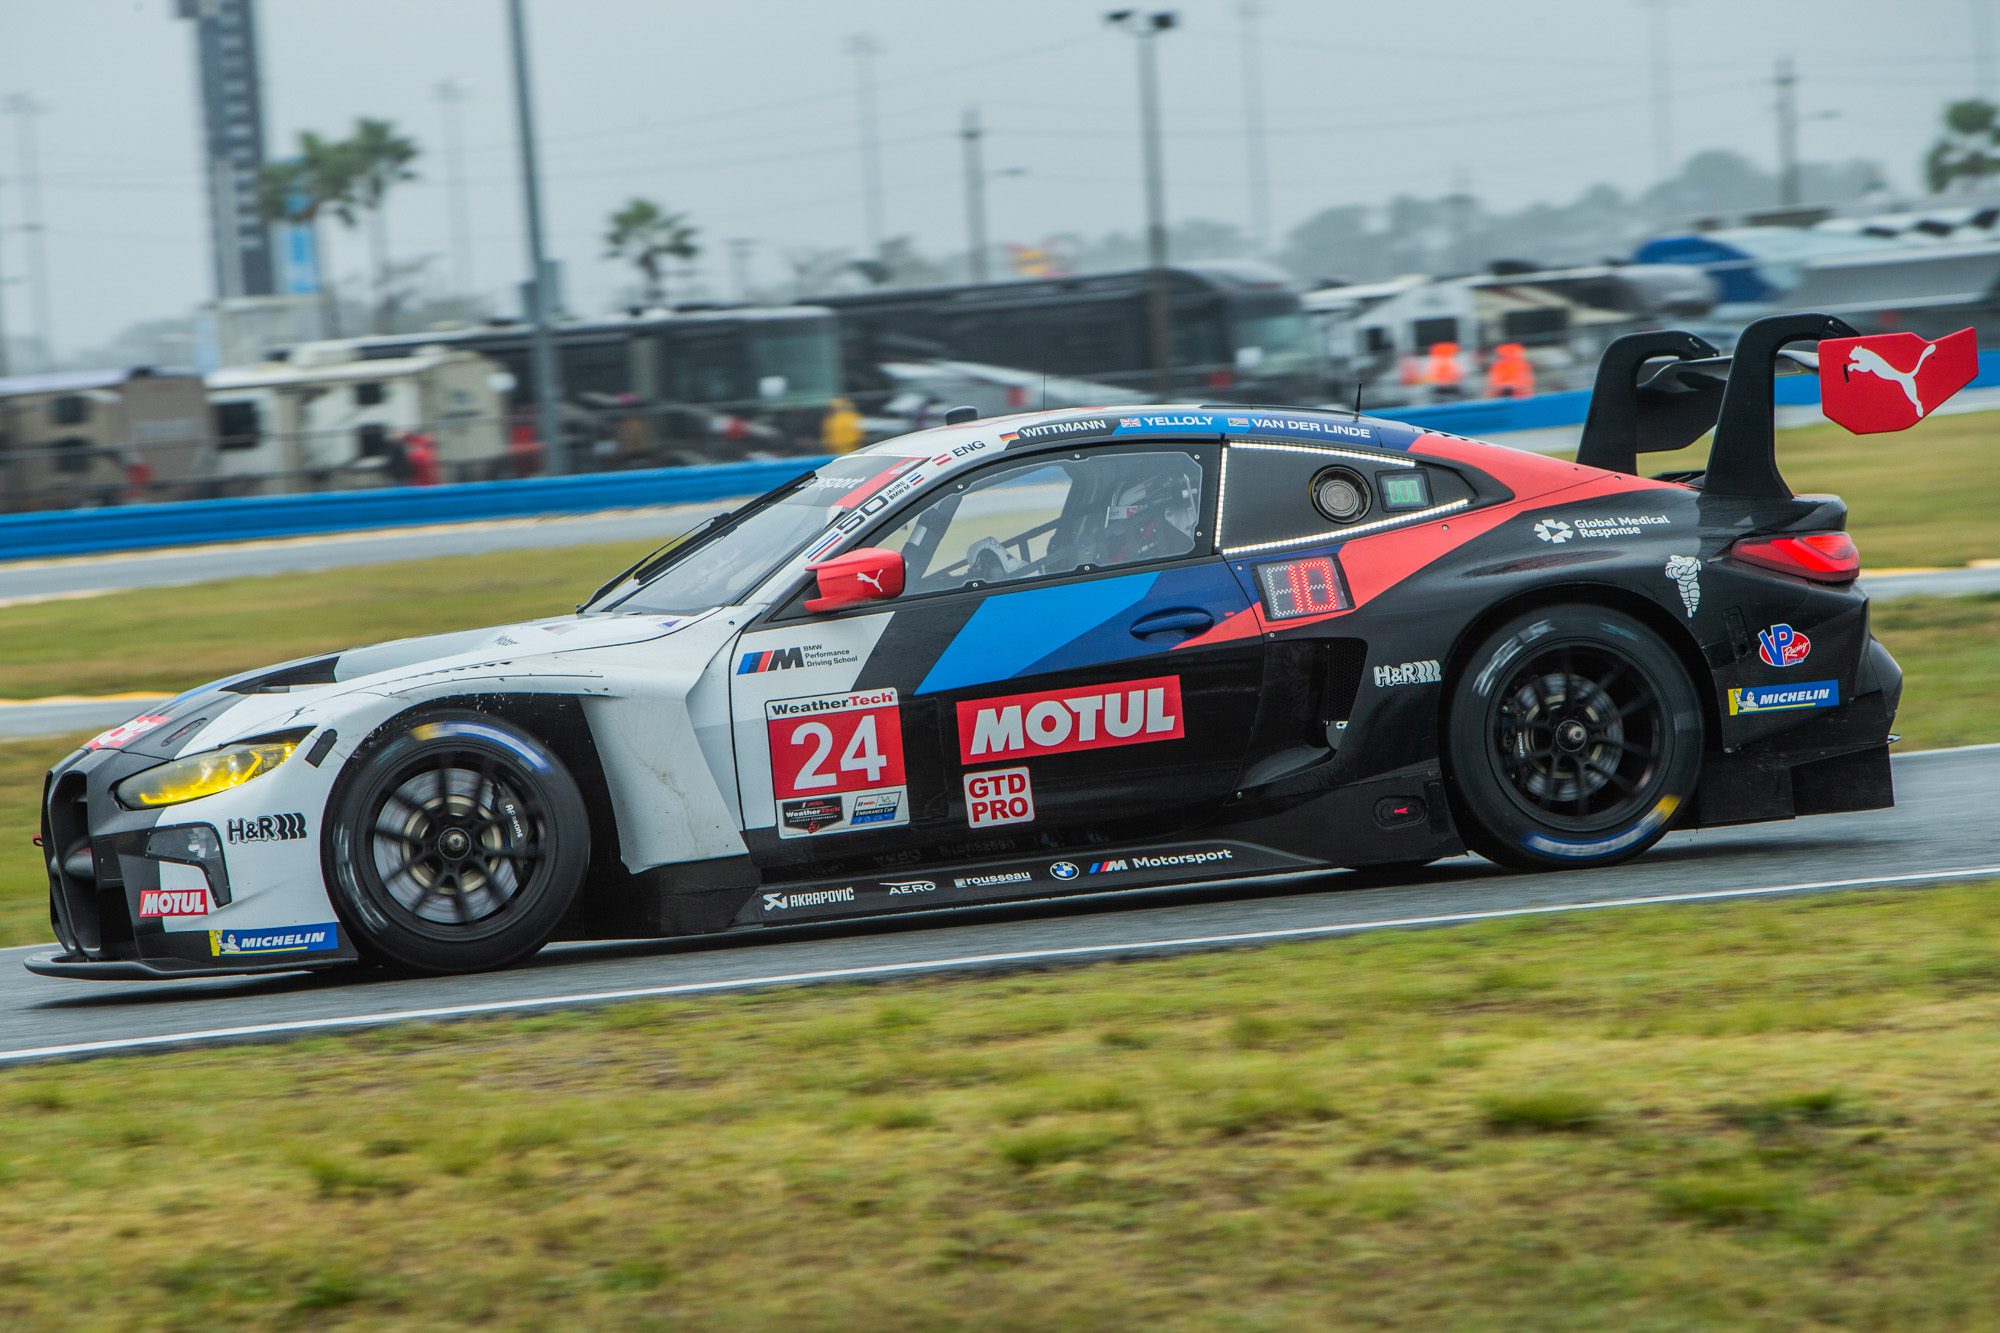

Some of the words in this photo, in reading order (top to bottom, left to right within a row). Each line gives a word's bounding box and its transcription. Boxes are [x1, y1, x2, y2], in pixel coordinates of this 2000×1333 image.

[1020, 420, 1107, 438] WITTMANN
[1143, 415, 1214, 427] YELLOLY
[1252, 418, 1285, 429] VAN
[1288, 421, 1321, 432] DER
[1324, 424, 1371, 439] LINDE
[952, 440, 987, 457] ENG
[889, 487, 905, 500] BMW
[836, 494, 890, 535] 50
[1574, 518, 1617, 529] Global
[1617, 515, 1670, 526] Medical
[1579, 526, 1642, 538] Response
[803, 644, 823, 652] BMW
[1758, 624, 1794, 665] VP
[1784, 641, 1808, 659] Racing
[805, 649, 850, 659] Performance
[833, 656, 858, 664] School
[1374, 662, 1419, 687] H&R
[771, 693, 892, 715] WeatherTech
[1760, 688, 1829, 705] MICHELIN
[970, 688, 1176, 755] MOTUL
[790, 714, 888, 791] 24
[968, 773, 1026, 799] GTD
[971, 796, 1029, 823] PRO
[227, 815, 280, 845] H&R
[1131, 848, 1233, 869] Motorsport
[965, 872, 1032, 885] rousseau
[888, 882, 937, 896] AERO
[141, 888, 205, 915] MOTUL
[241, 931, 326, 949] MICHELIN
